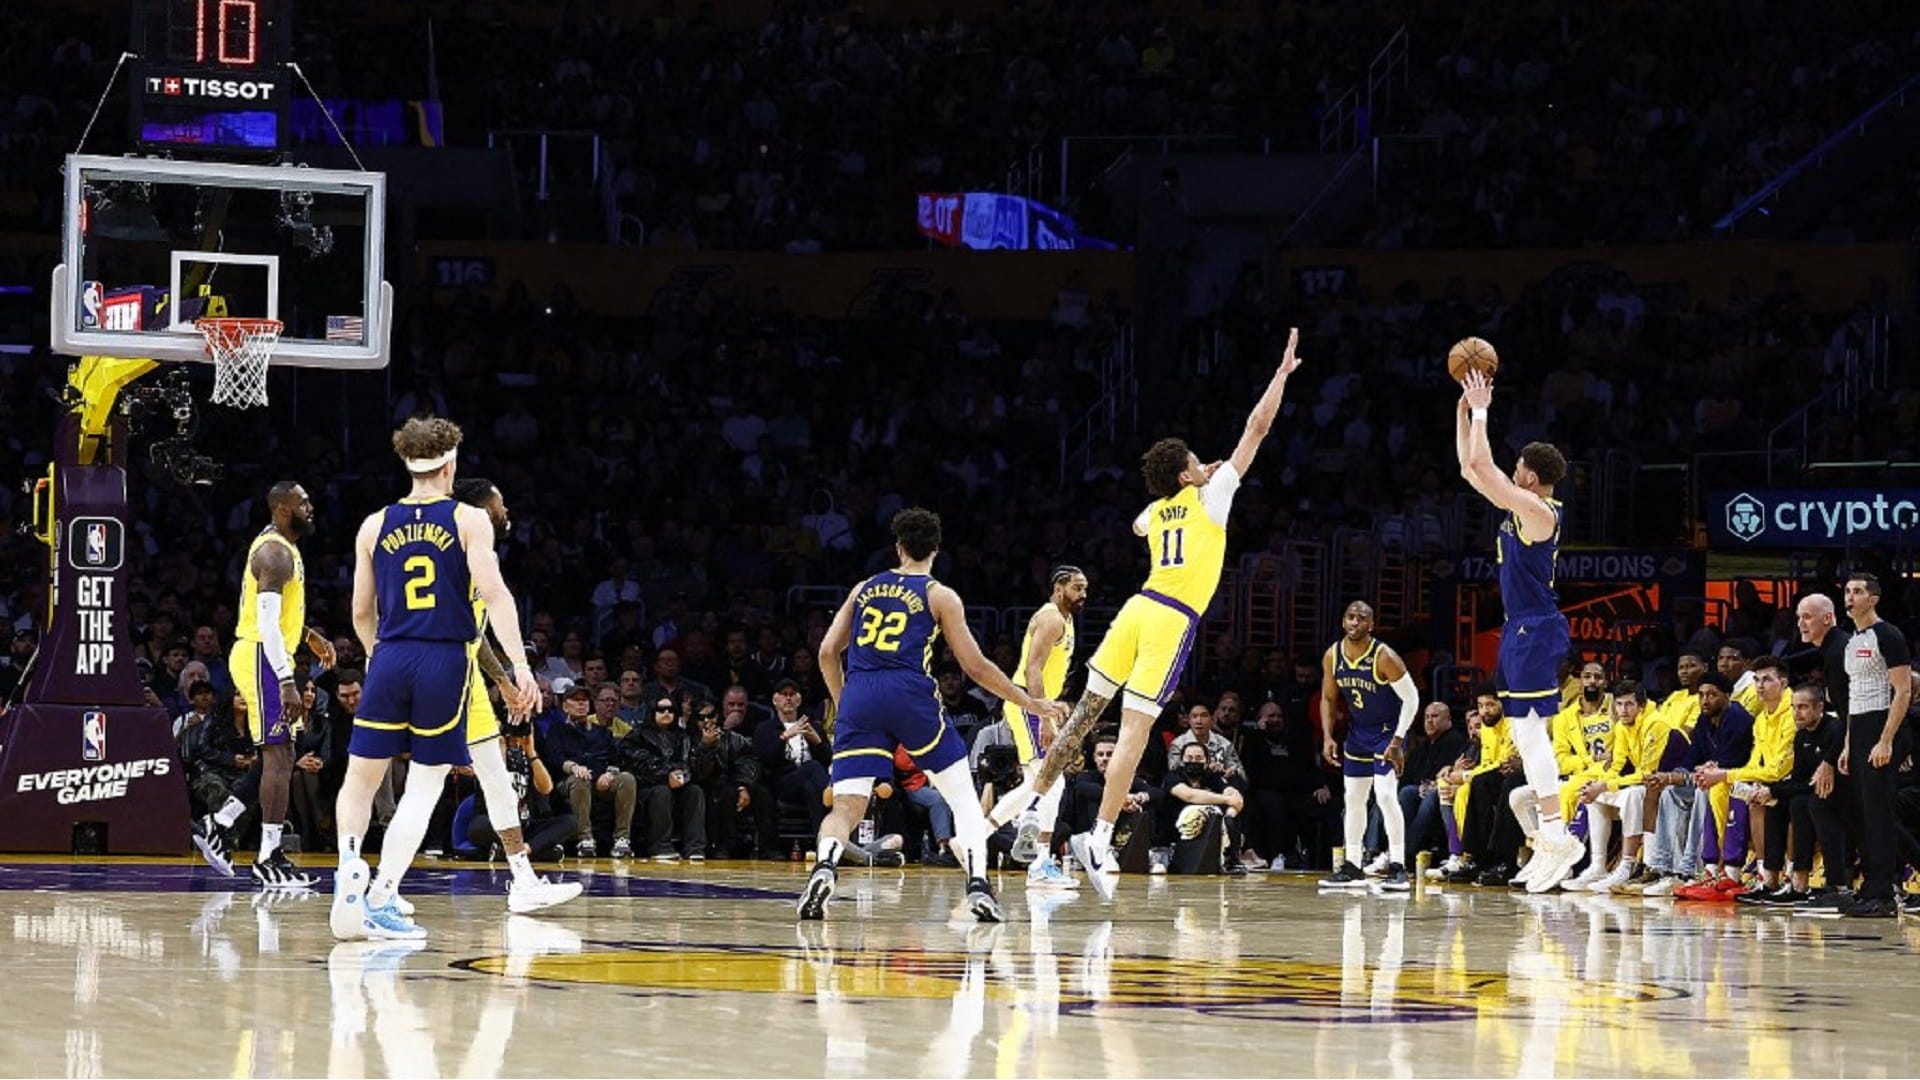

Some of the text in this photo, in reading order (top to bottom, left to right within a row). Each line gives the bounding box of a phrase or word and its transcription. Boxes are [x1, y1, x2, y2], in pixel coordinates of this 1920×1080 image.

[196, 0, 256, 64] 10
[183, 77, 275, 100] TISSOT
[1301, 268, 1345, 296] 117
[1160, 527, 1184, 567] 11
[1557, 553, 1656, 579] MPIONS
[77, 575, 115, 608] GET
[403, 555, 437, 610] 2
[76, 610, 115, 642] THE
[856, 606, 908, 652] 32
[75, 643, 115, 675] APP
[1351, 688, 1364, 709] 3
[17, 758, 171, 793] EVERYONE'S
[57, 778, 129, 805] GAME
